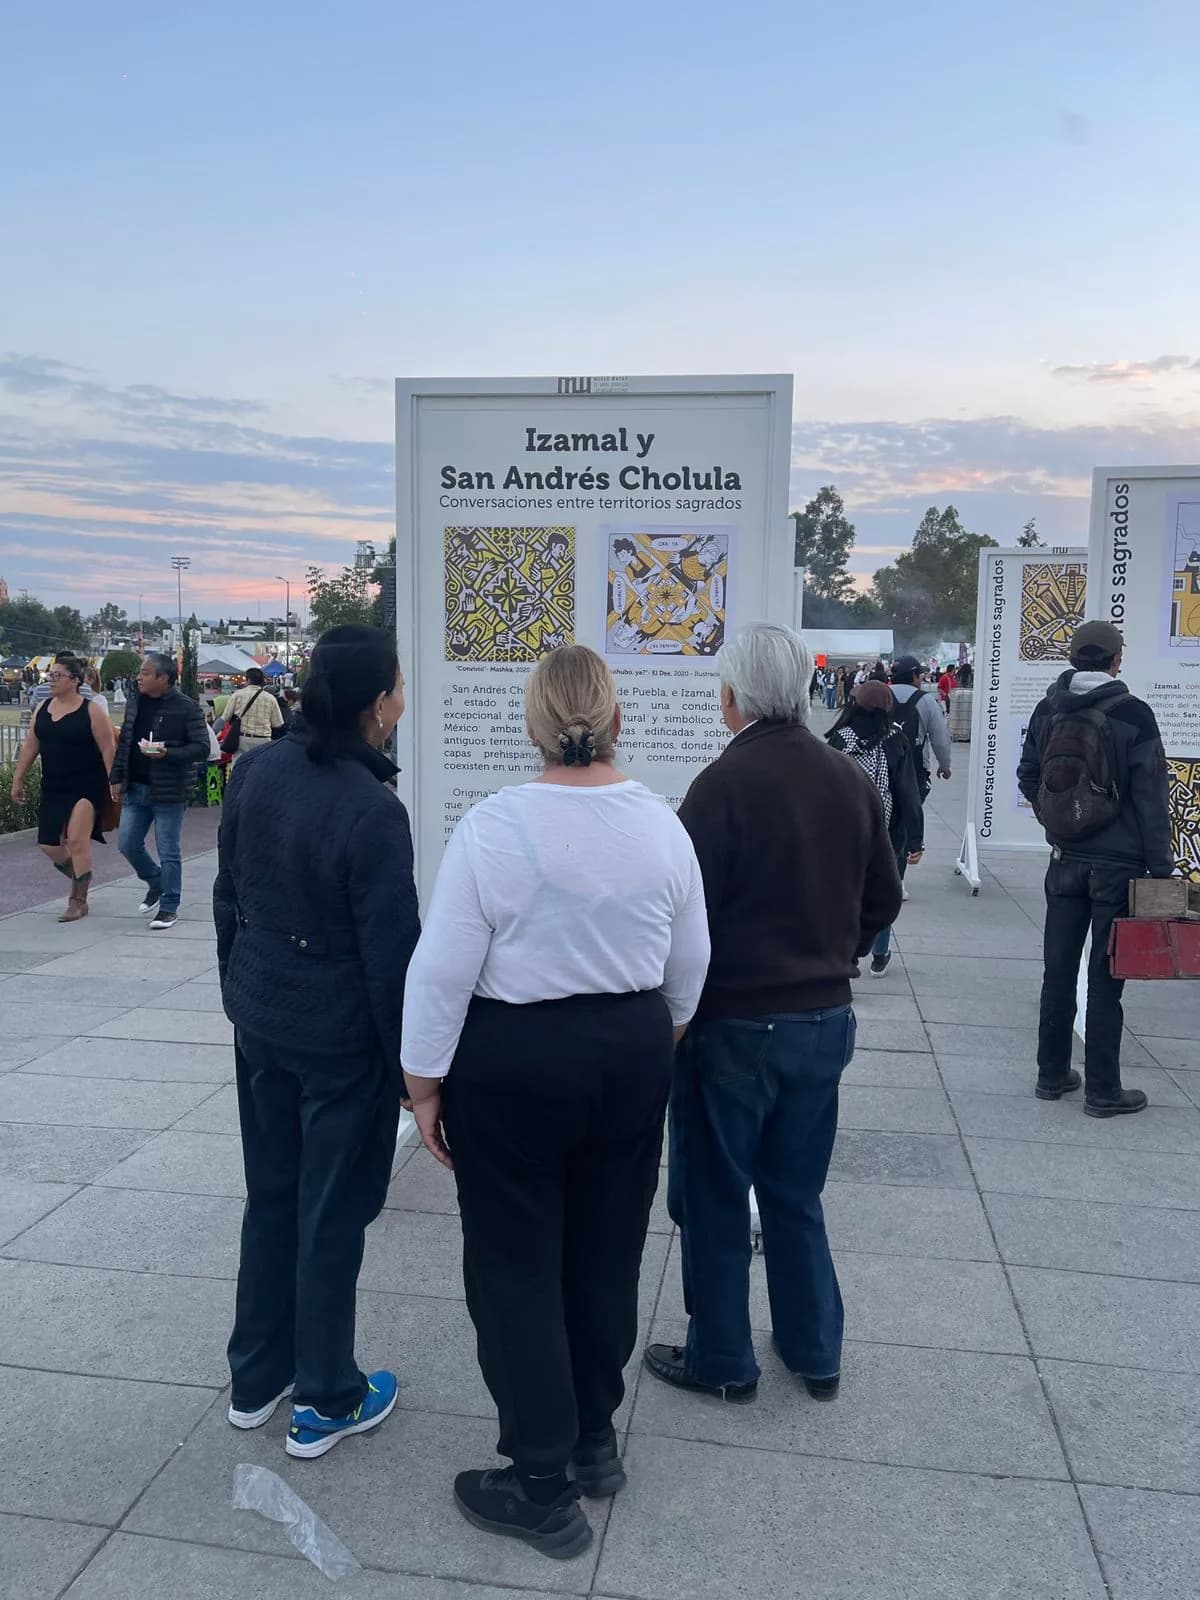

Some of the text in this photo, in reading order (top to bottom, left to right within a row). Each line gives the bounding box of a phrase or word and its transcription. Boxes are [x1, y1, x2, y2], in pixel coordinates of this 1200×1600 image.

[525, 427, 655, 458] Izamal y
[440, 465, 742, 491] San Andrés Cholula
[439, 495, 742, 512] Conversaciones entre territorios sagrados
[1110, 483, 1132, 586] sagrados
[452, 684, 470, 694] San
[616, 687, 630, 696] de
[632, 687, 669, 698] Puebla,
[681, 688, 717, 699] Izamal,
[1154, 682, 1180, 690] Izamal
[980, 559, 1006, 838] Conversaciones entre territorios sagrados
[1146, 692, 1198, 700] peregrinación
[443, 698, 453, 706] el
[464, 699, 497, 707] estado
[508, 699, 520, 708] de
[443, 711, 502, 720] excepcional
[651, 715, 658, 724] y
[664, 714, 714, 724] simbólico
[1182, 711, 1197, 719] San
[490, 724, 522, 733] ambas
[644, 726, 695, 737] edificadas
[704, 728, 732, 738] sobre
[443, 737, 486, 746] antiguos
[681, 741, 713, 750] donde
[443, 750, 472, 759] capas
[628, 754, 634, 763] y
[443, 763, 490, 771] coexisten
[444, 802, 463, 810] que
